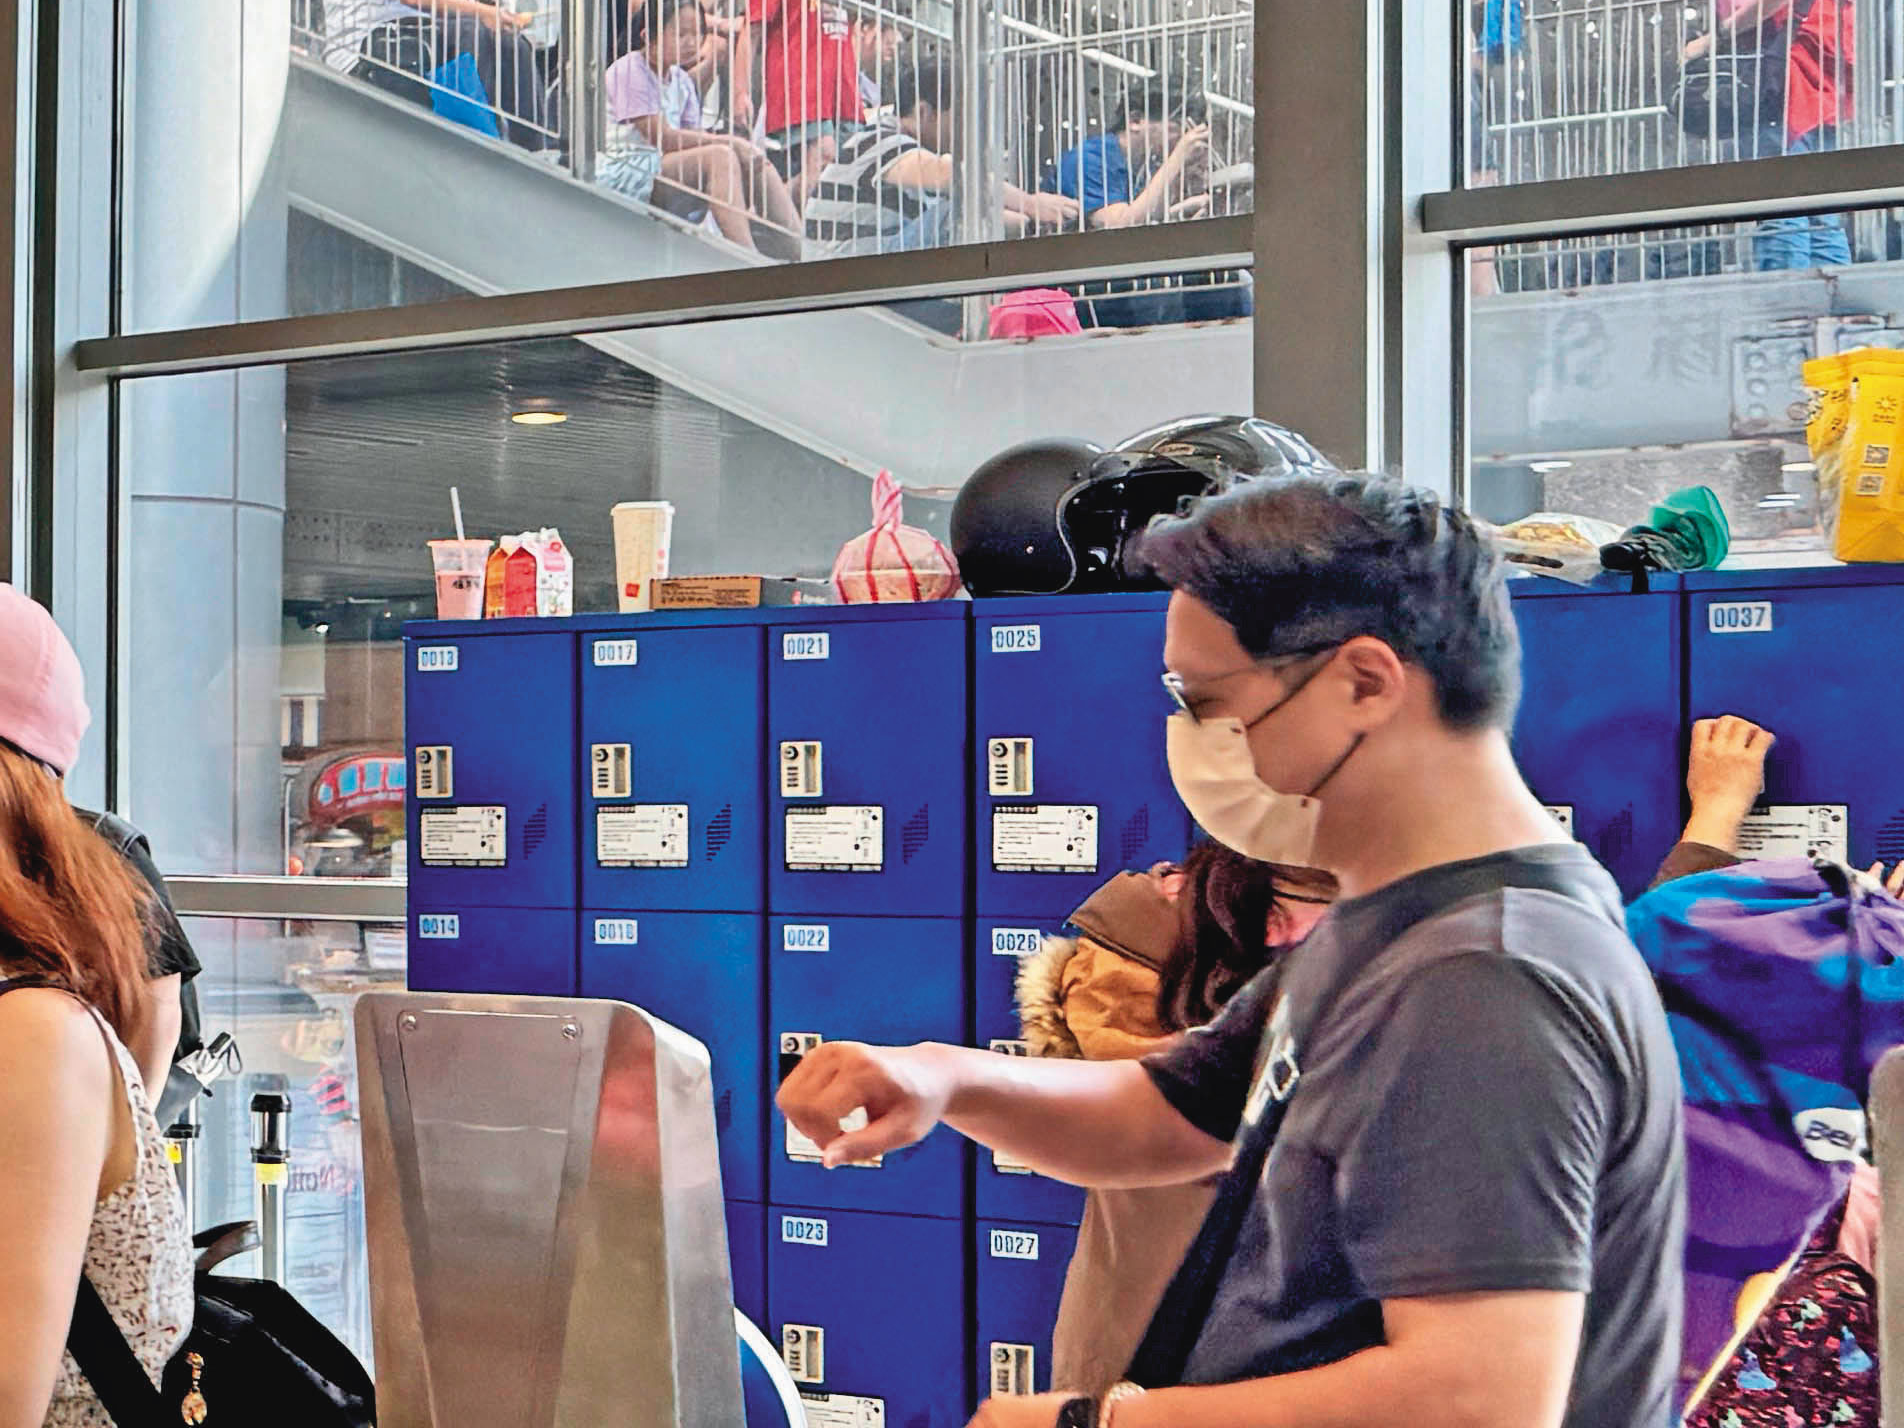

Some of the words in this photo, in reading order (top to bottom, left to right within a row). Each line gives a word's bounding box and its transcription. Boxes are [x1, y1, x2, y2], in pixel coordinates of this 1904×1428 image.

[1714, 606, 1766, 628] 0037
[787, 637, 824, 655] 0021
[995, 629, 1037, 649] 0025
[597, 644, 633, 662] 0017
[787, 929, 825, 947] 0022
[996, 933, 1037, 951] 0026
[785, 1220, 825, 1241] 0023
[993, 1234, 1036, 1255] 0027
